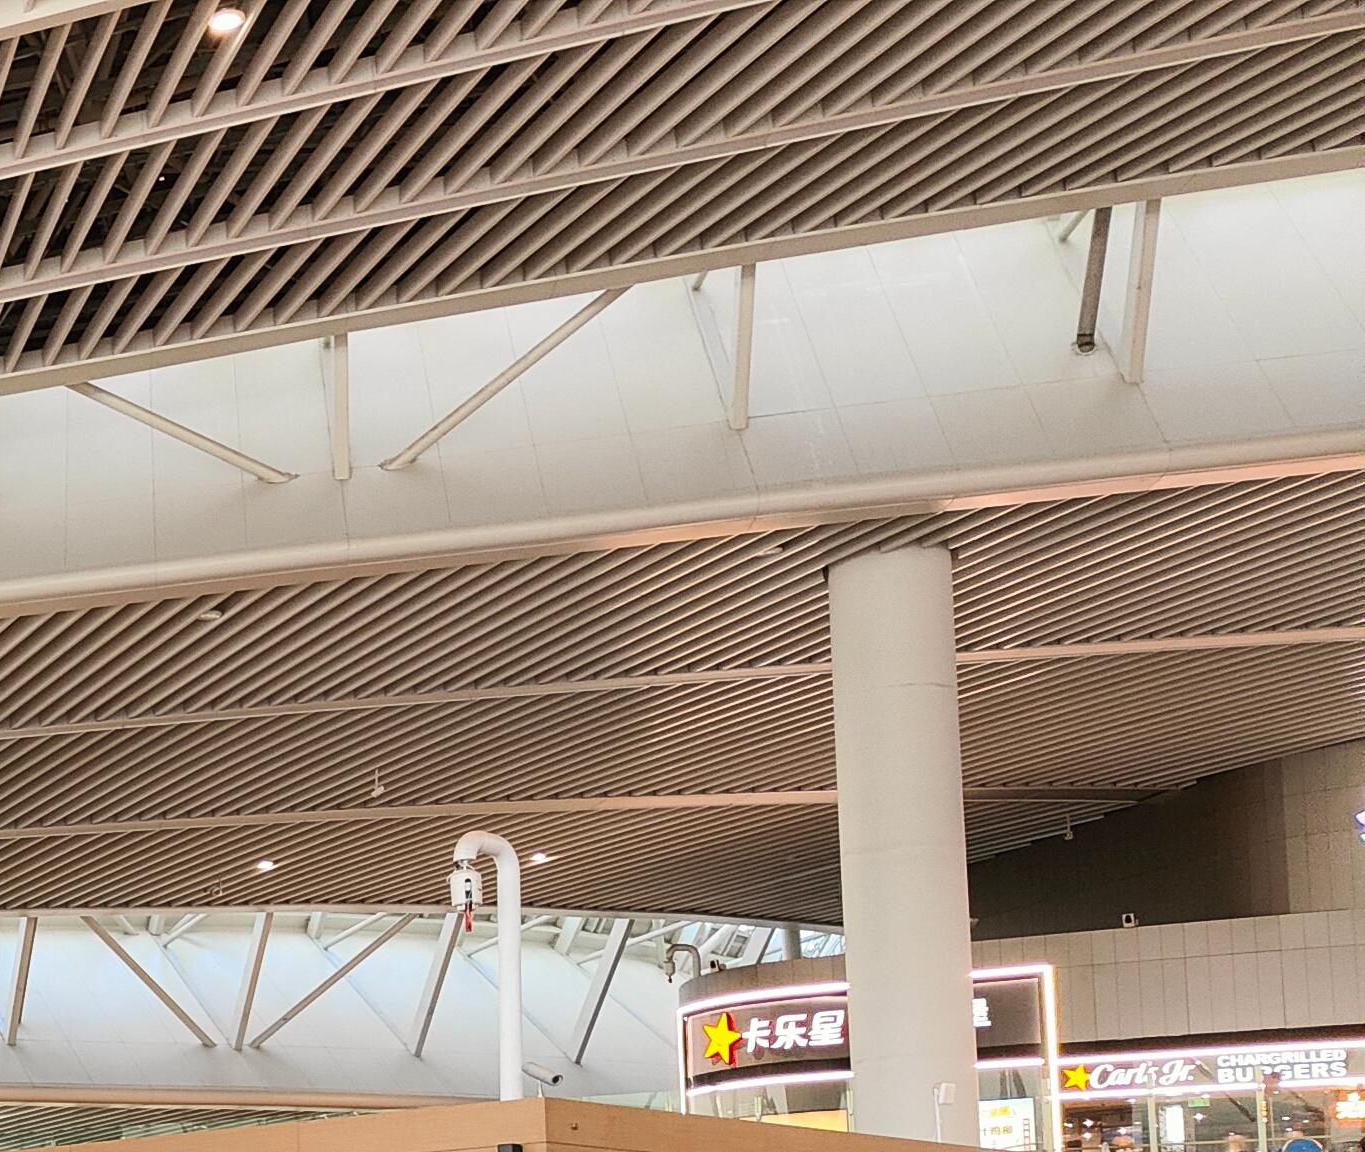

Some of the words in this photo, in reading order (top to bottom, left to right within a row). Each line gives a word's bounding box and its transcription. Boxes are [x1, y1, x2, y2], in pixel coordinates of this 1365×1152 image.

[742, 1008, 845, 1053] 卡乐星
[1217, 1049, 1347, 1067] CHARGRILLED
[1159, 1059, 1194, 1085] Jr.
